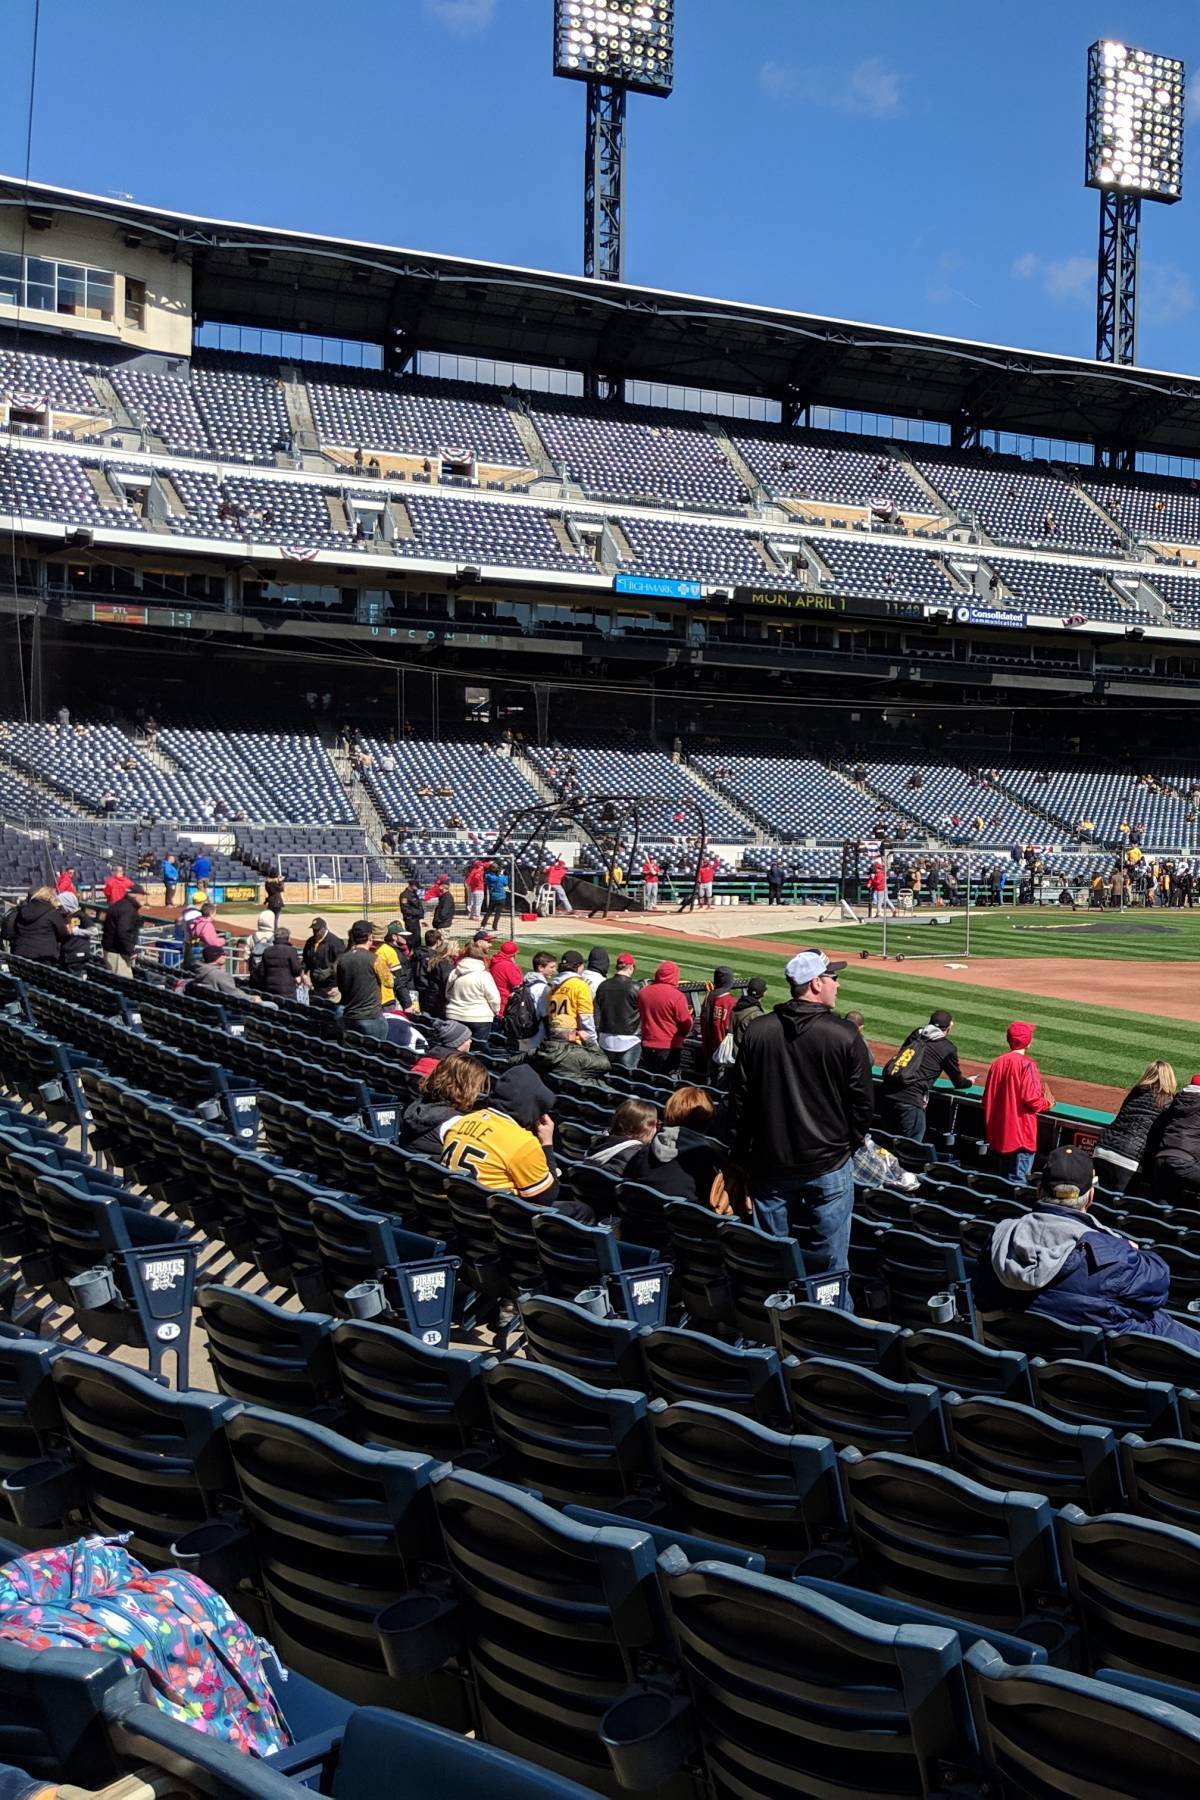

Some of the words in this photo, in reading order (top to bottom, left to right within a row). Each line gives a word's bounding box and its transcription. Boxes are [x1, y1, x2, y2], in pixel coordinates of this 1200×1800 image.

[623, 579, 673, 594] HIGHMARK
[752, 594, 791, 608] MON,
[795, 595, 836, 610] APRIL
[840, 597, 846, 611] 1
[971, 617, 1024, 627] communications
[972, 609, 1024, 622] Consolidated
[457, 1120, 494, 1142] COLE
[144, 1258, 185, 1281] PIRATES
[411, 1270, 446, 1293] PIRATES
[165, 1326, 172, 1337] J
[427, 1333, 436, 1343] H
